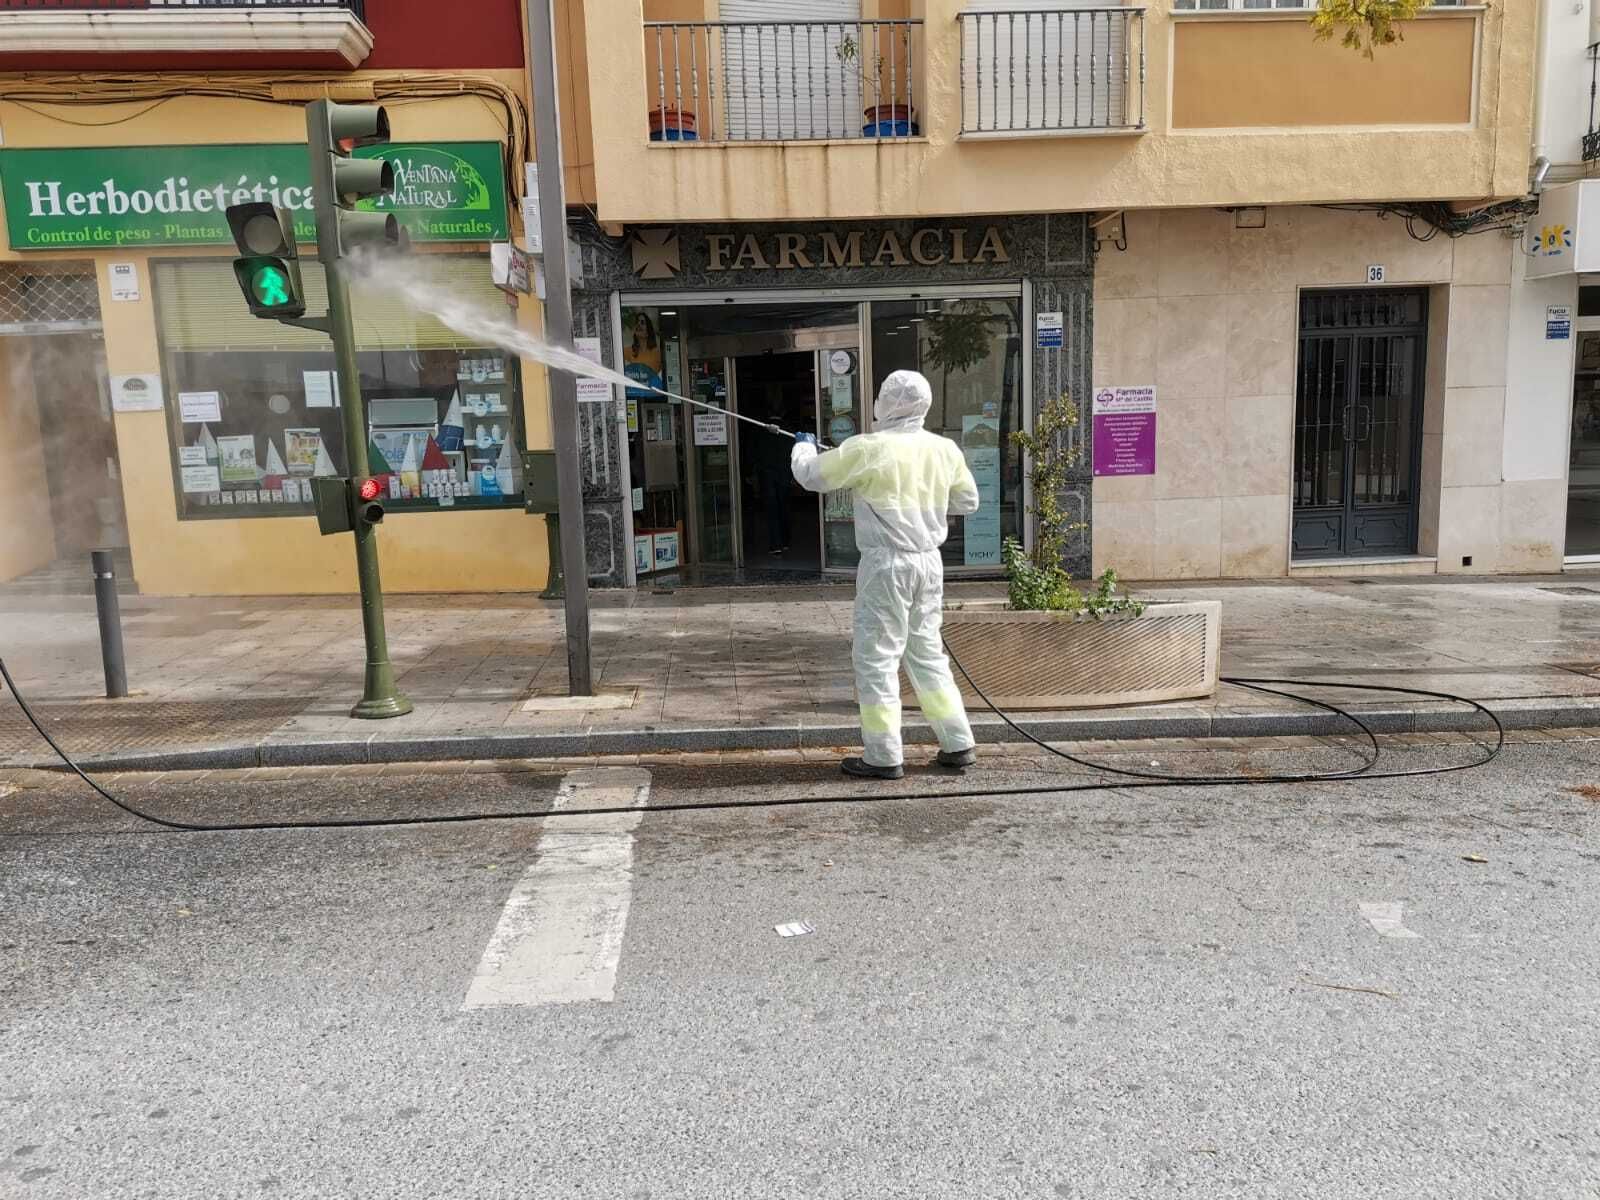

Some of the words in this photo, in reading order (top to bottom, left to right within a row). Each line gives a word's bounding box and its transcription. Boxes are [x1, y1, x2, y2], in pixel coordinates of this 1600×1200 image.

[27, 225, 90, 243] Control
[94, 226, 112, 241] de
[115, 226, 150, 244] peso
[164, 223, 223, 240] Plantas
[417, 218, 492, 235] Naturales
[705, 226, 1010, 271] FARMACIA
[1370, 267, 1383, 281] 36
[1115, 388, 1153, 396] Farmacia
[968, 551, 995, 559] VICHY
